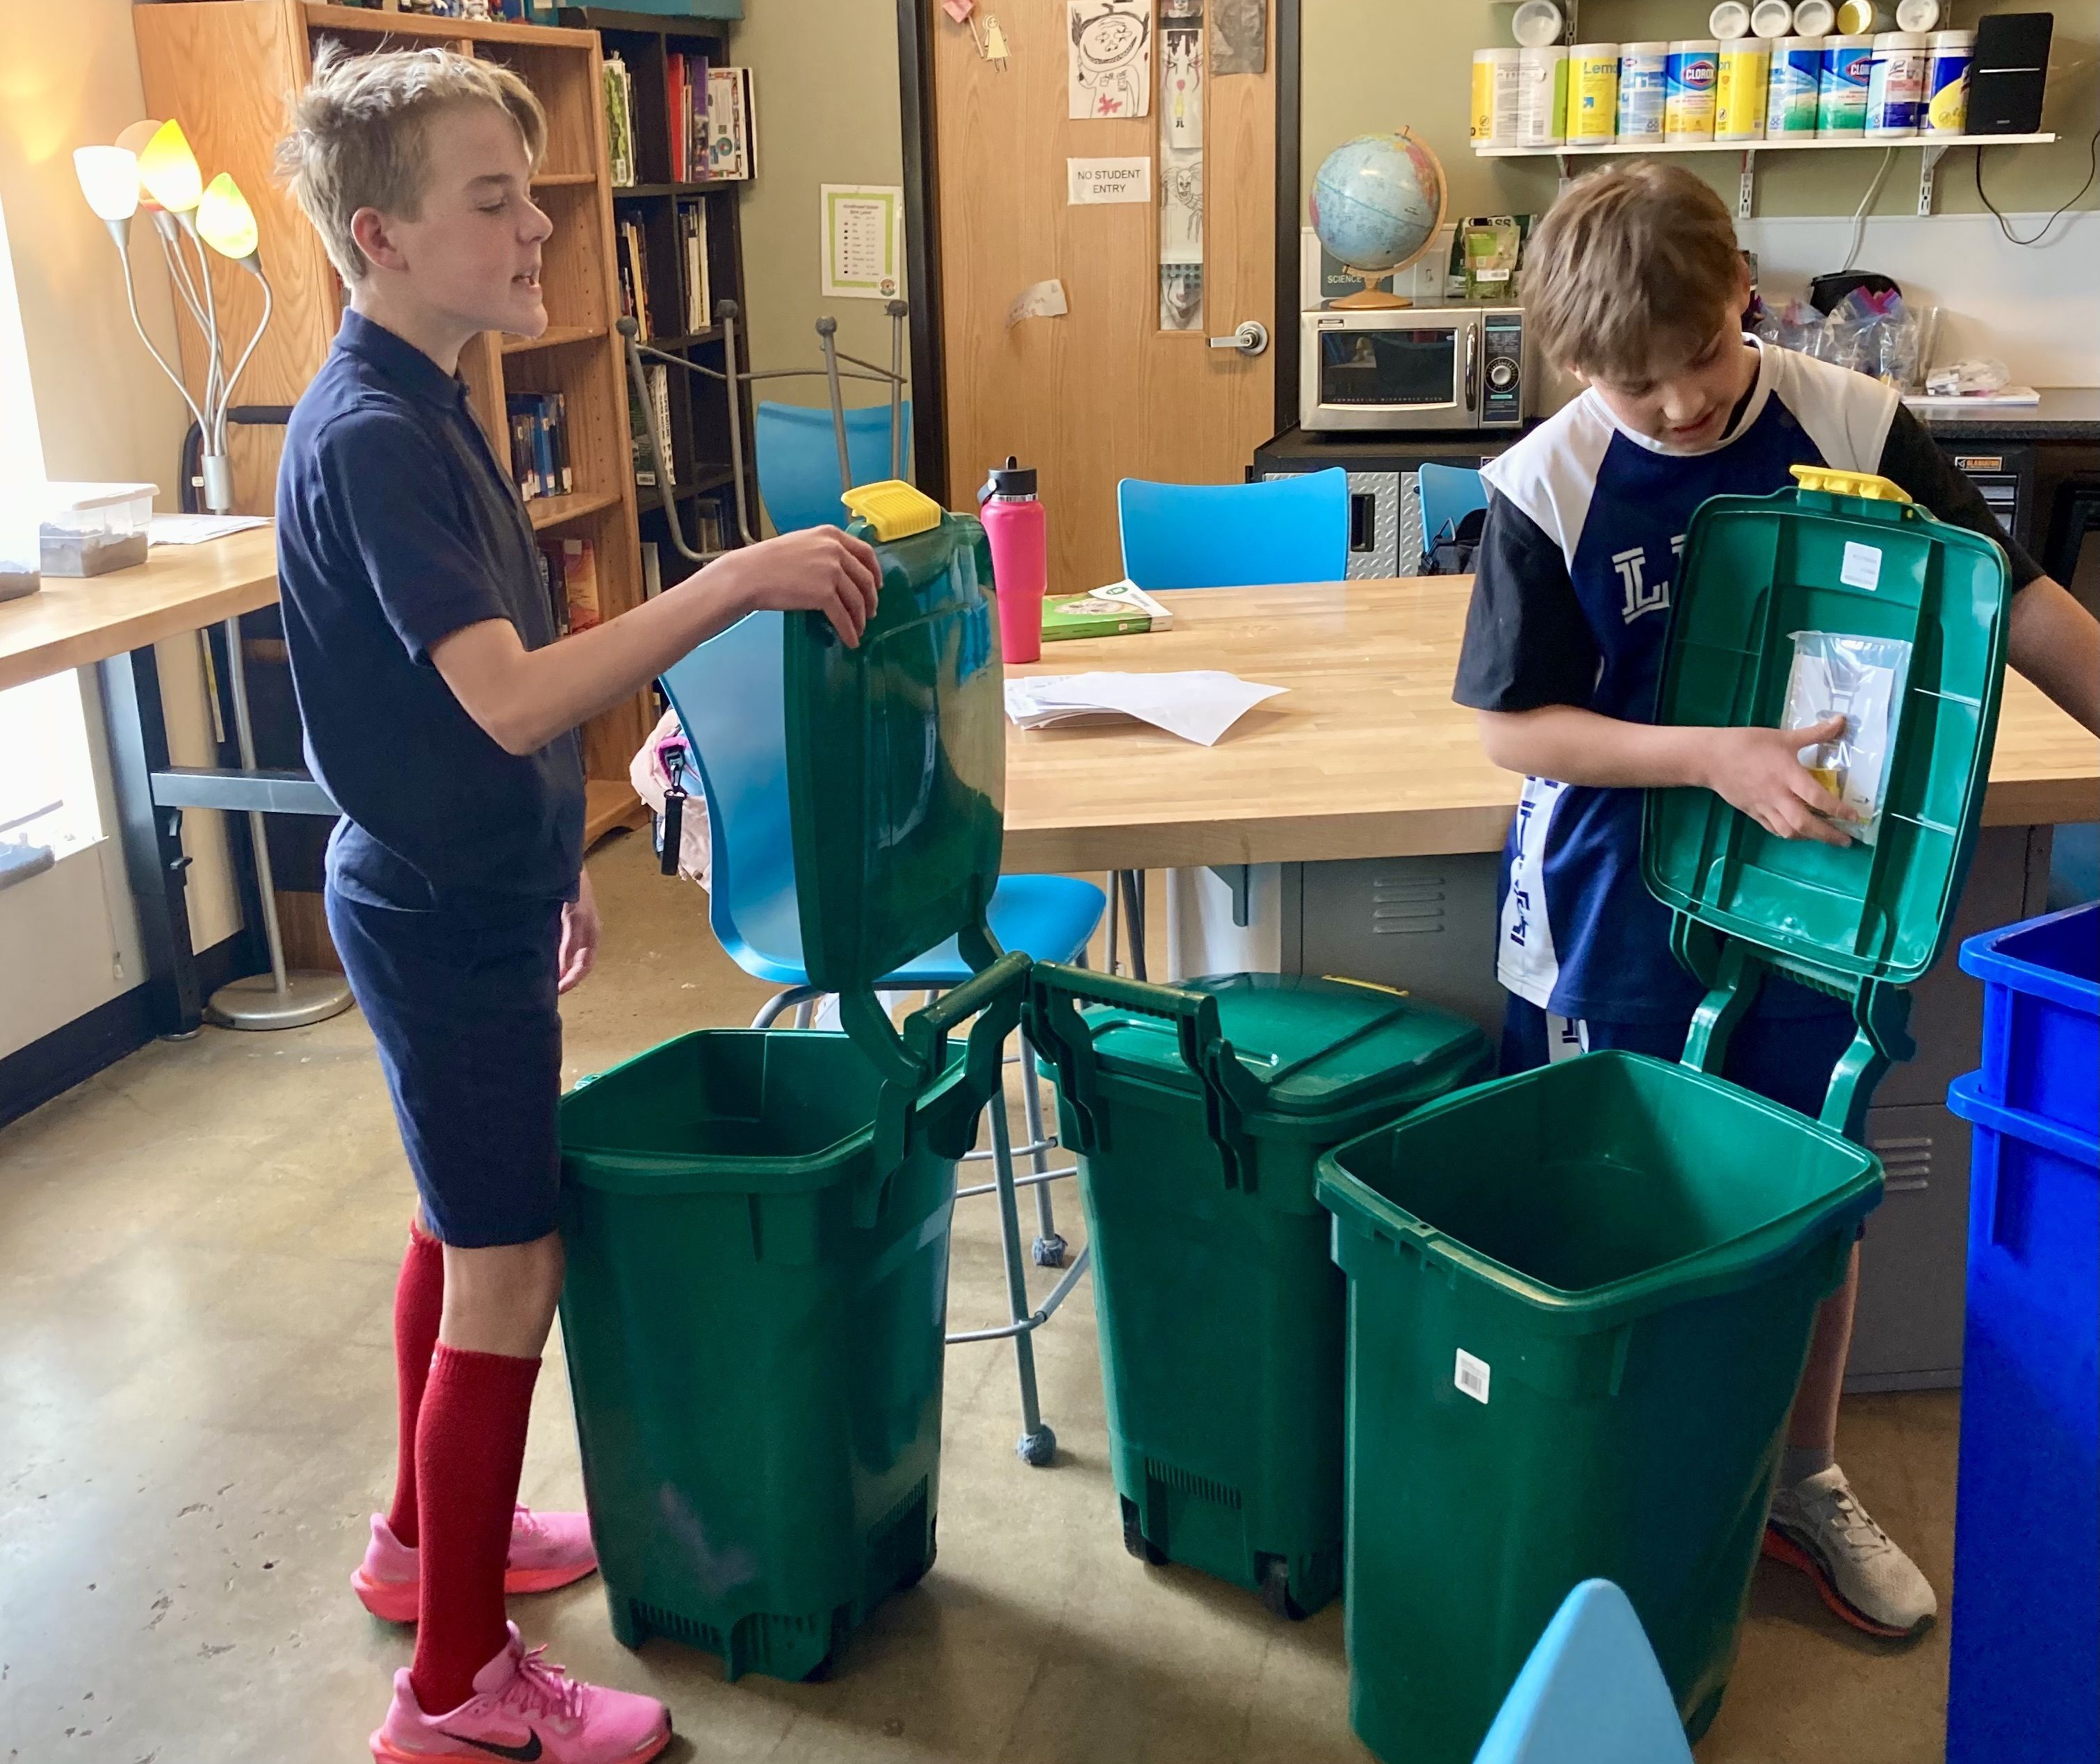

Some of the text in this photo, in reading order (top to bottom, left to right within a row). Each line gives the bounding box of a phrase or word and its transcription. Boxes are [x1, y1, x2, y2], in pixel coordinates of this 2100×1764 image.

[1077, 170, 1141, 180] NO STUDENT
[1093, 183, 1126, 193] ENTRY
[1327, 275, 1362, 284] SCIENCE
